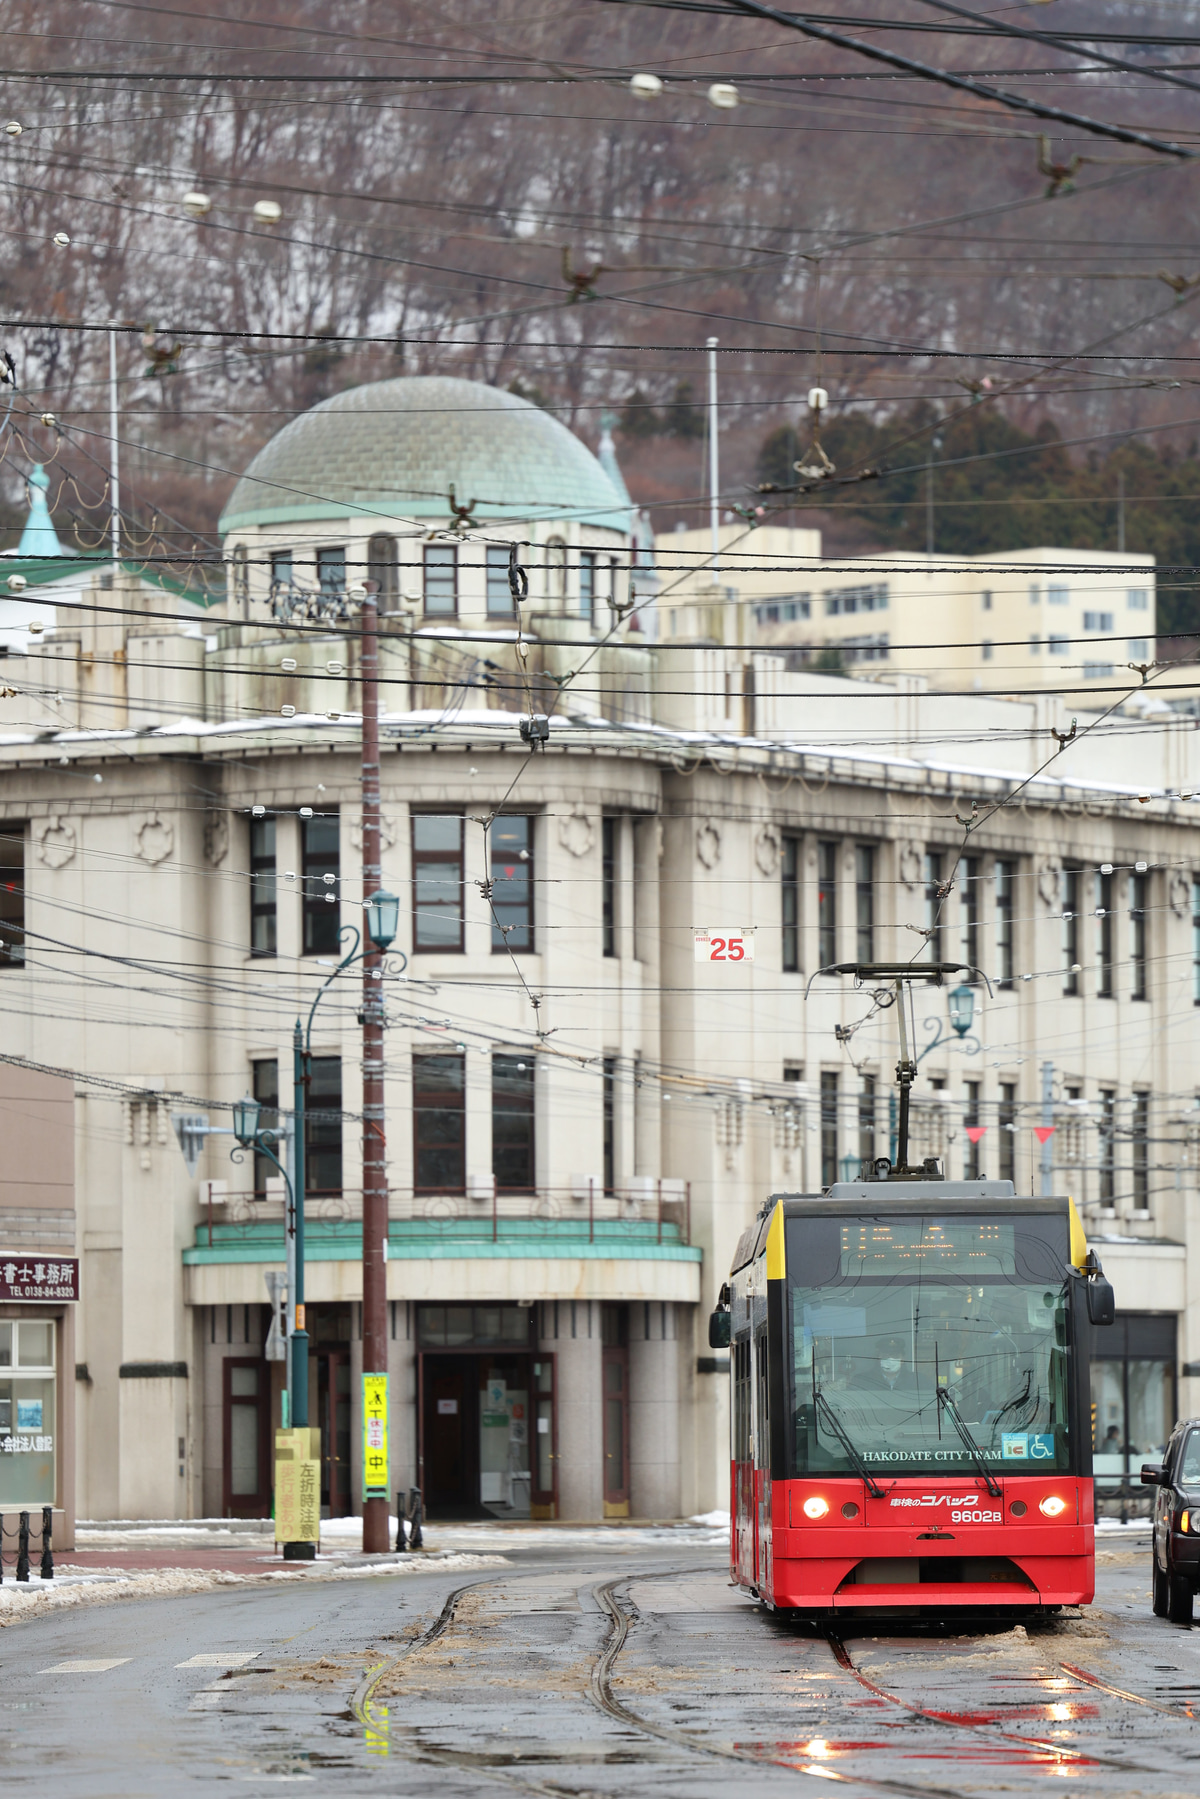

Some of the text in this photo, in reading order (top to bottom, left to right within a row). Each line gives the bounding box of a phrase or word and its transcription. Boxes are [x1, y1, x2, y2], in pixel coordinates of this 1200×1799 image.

[710, 937, 745, 961] 25
[0, 1263, 74, 1285] 書士事務所
[9, 1286, 23, 1297] TEL
[863, 1450, 1003, 1461] HAKODATE CITY TRAM
[280, 1464, 295, 1538] 歩行者あり
[299, 1463, 315, 1539] 左折時注意
[890, 1495, 979, 1507] 車検のコバック
[951, 1510, 1002, 1523] 9602B
